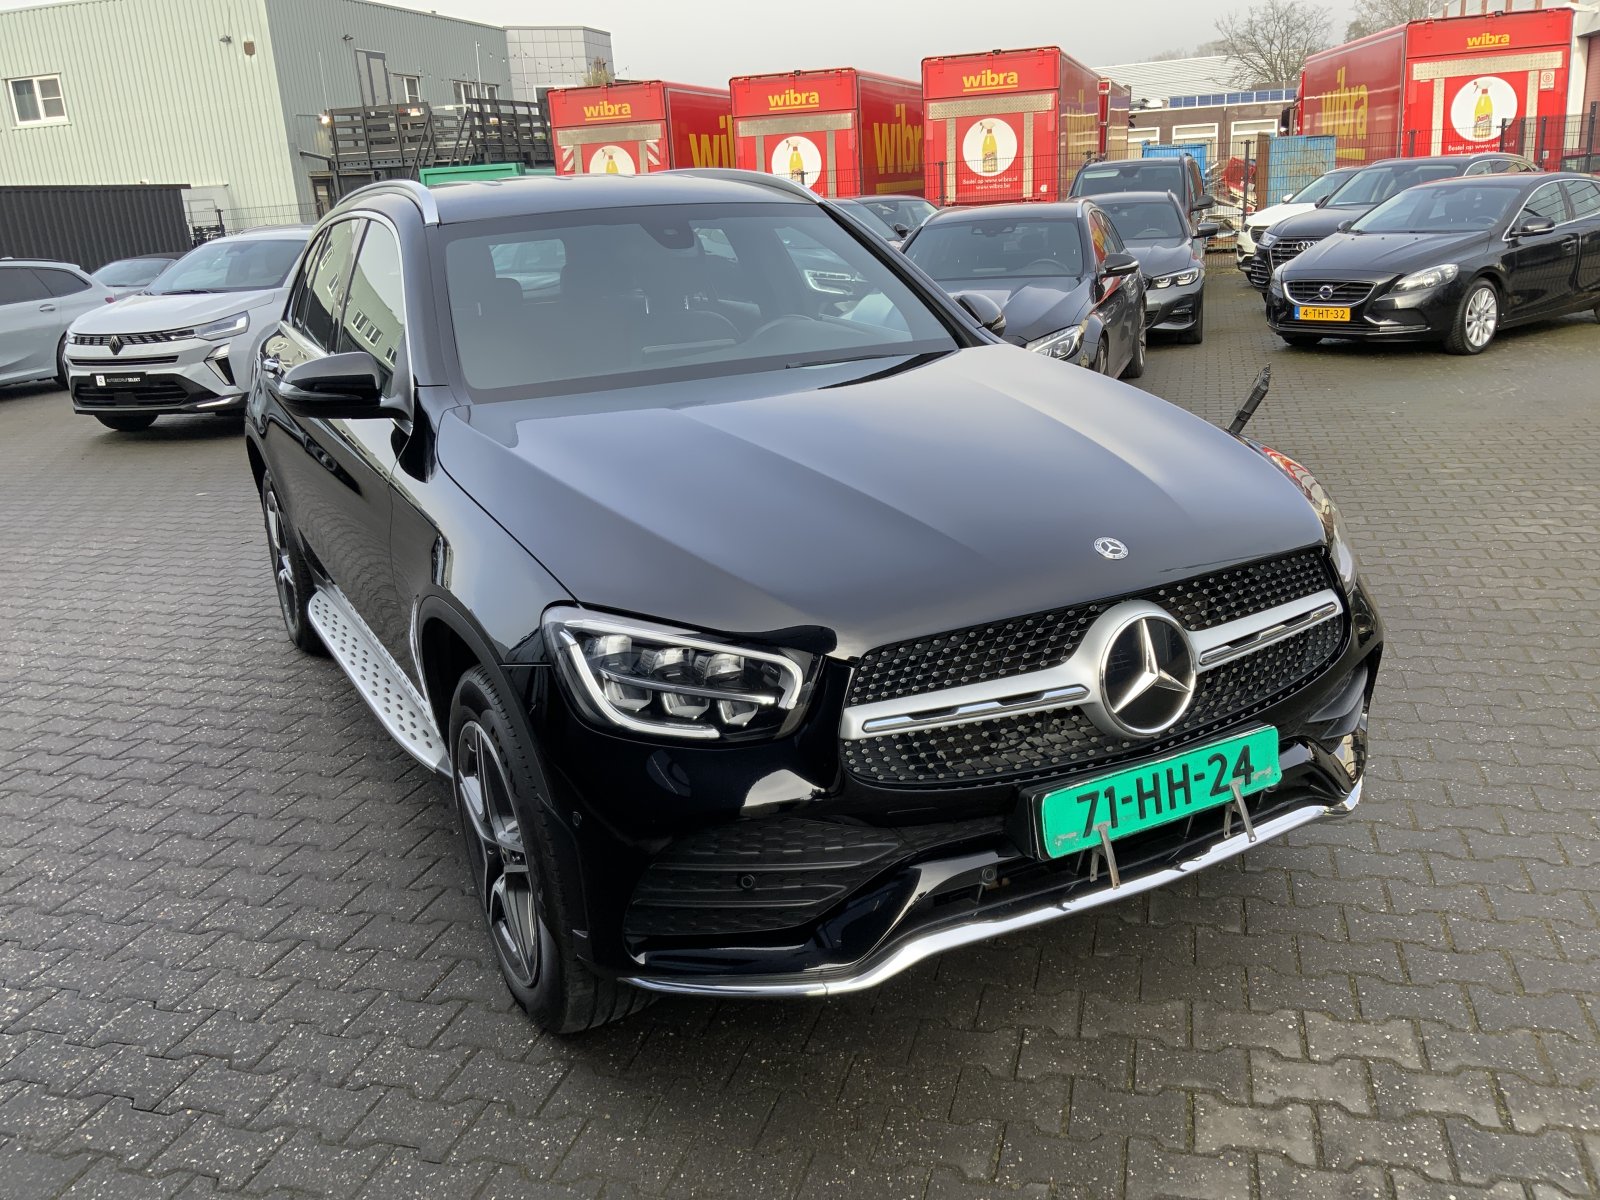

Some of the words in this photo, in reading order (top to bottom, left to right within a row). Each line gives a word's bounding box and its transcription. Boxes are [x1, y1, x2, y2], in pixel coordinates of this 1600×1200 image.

[1467, 32, 1510, 46] wibra
[962, 69, 1018, 88] wibra
[768, 88, 820, 107] wibra
[1322, 66, 1368, 139] wibra
[583, 100, 631, 117] wibra
[1303, 308, 1345, 319] 4-THT-32
[1076, 744, 1255, 838] 71-HH-24
